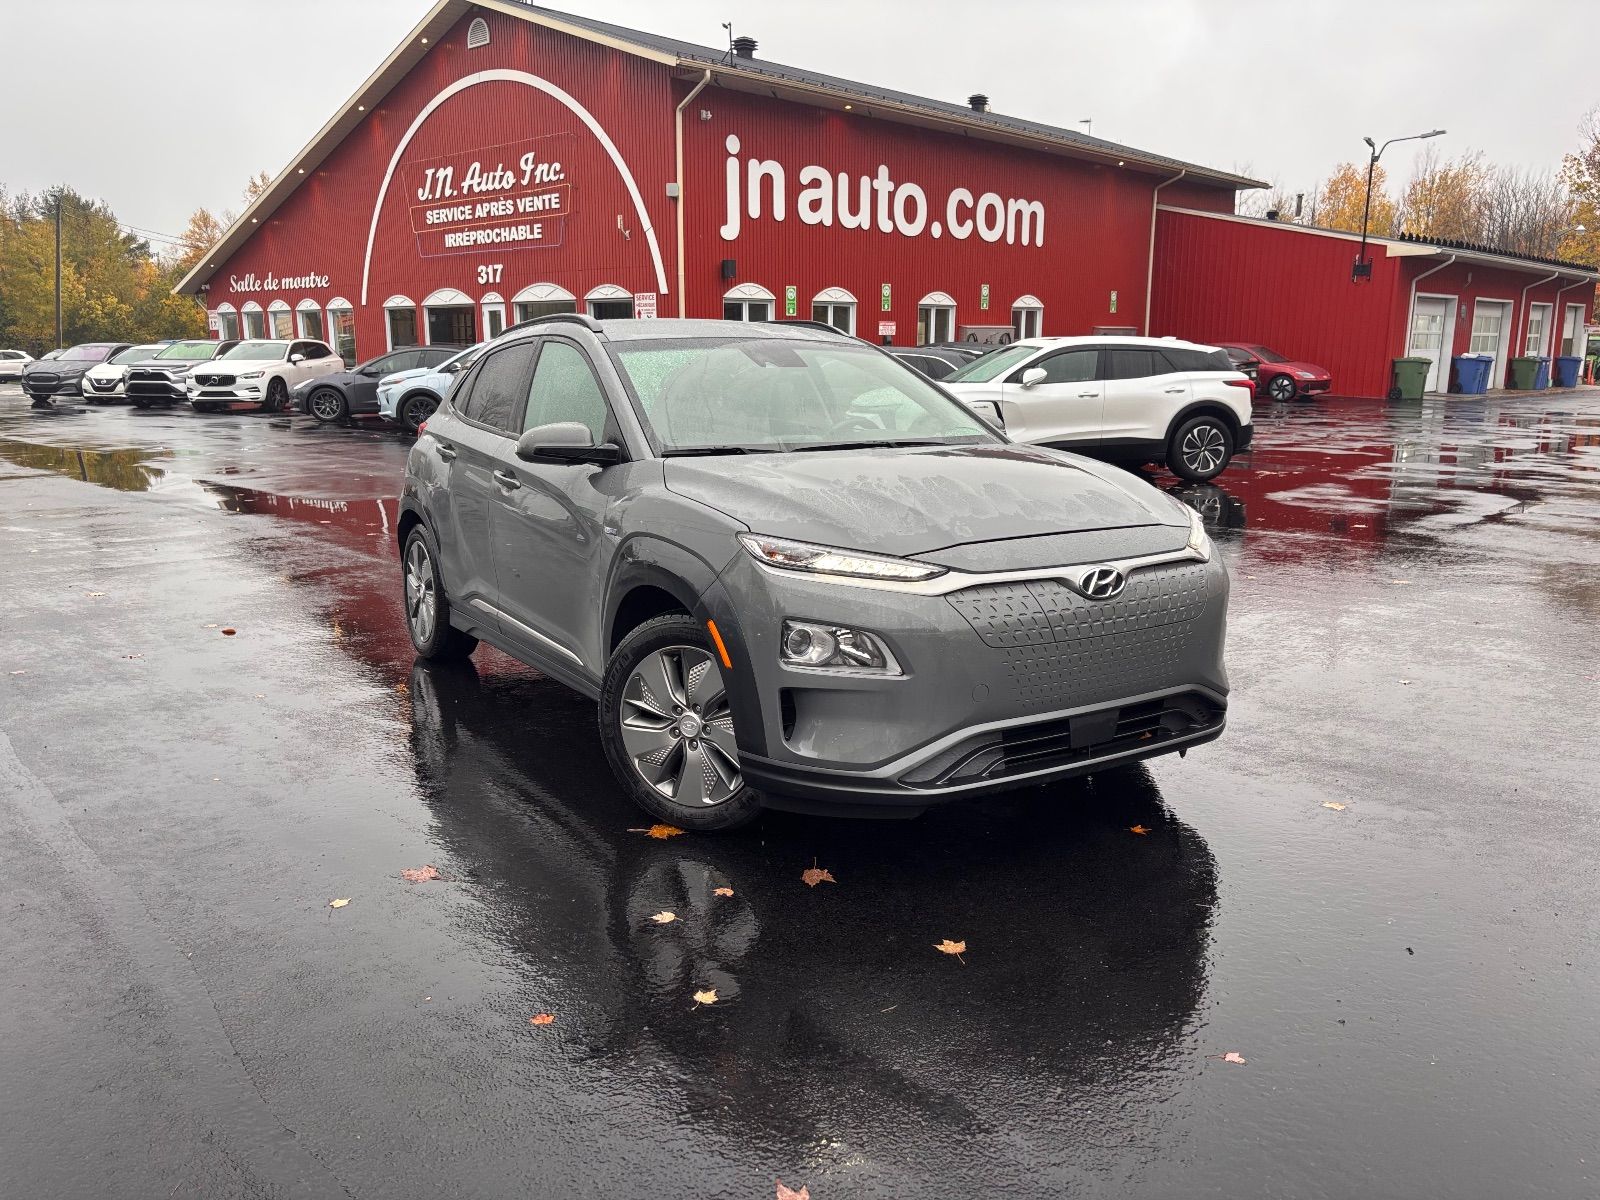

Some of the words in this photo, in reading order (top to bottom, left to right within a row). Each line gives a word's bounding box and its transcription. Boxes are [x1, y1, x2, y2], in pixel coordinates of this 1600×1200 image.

[417, 166, 458, 200] J.N.
[461, 161, 516, 194] Auto
[520, 151, 565, 186] Inc.
[426, 205, 473, 224] SERVICE
[475, 197, 514, 218] APRÈS
[516, 193, 560, 213] VENTE
[445, 223, 542, 248] IRRÉPROCHABLE
[229, 273, 262, 293] Salle
[263, 271, 280, 291] de
[281, 271, 330, 290] montre
[477, 264, 503, 285] 317
